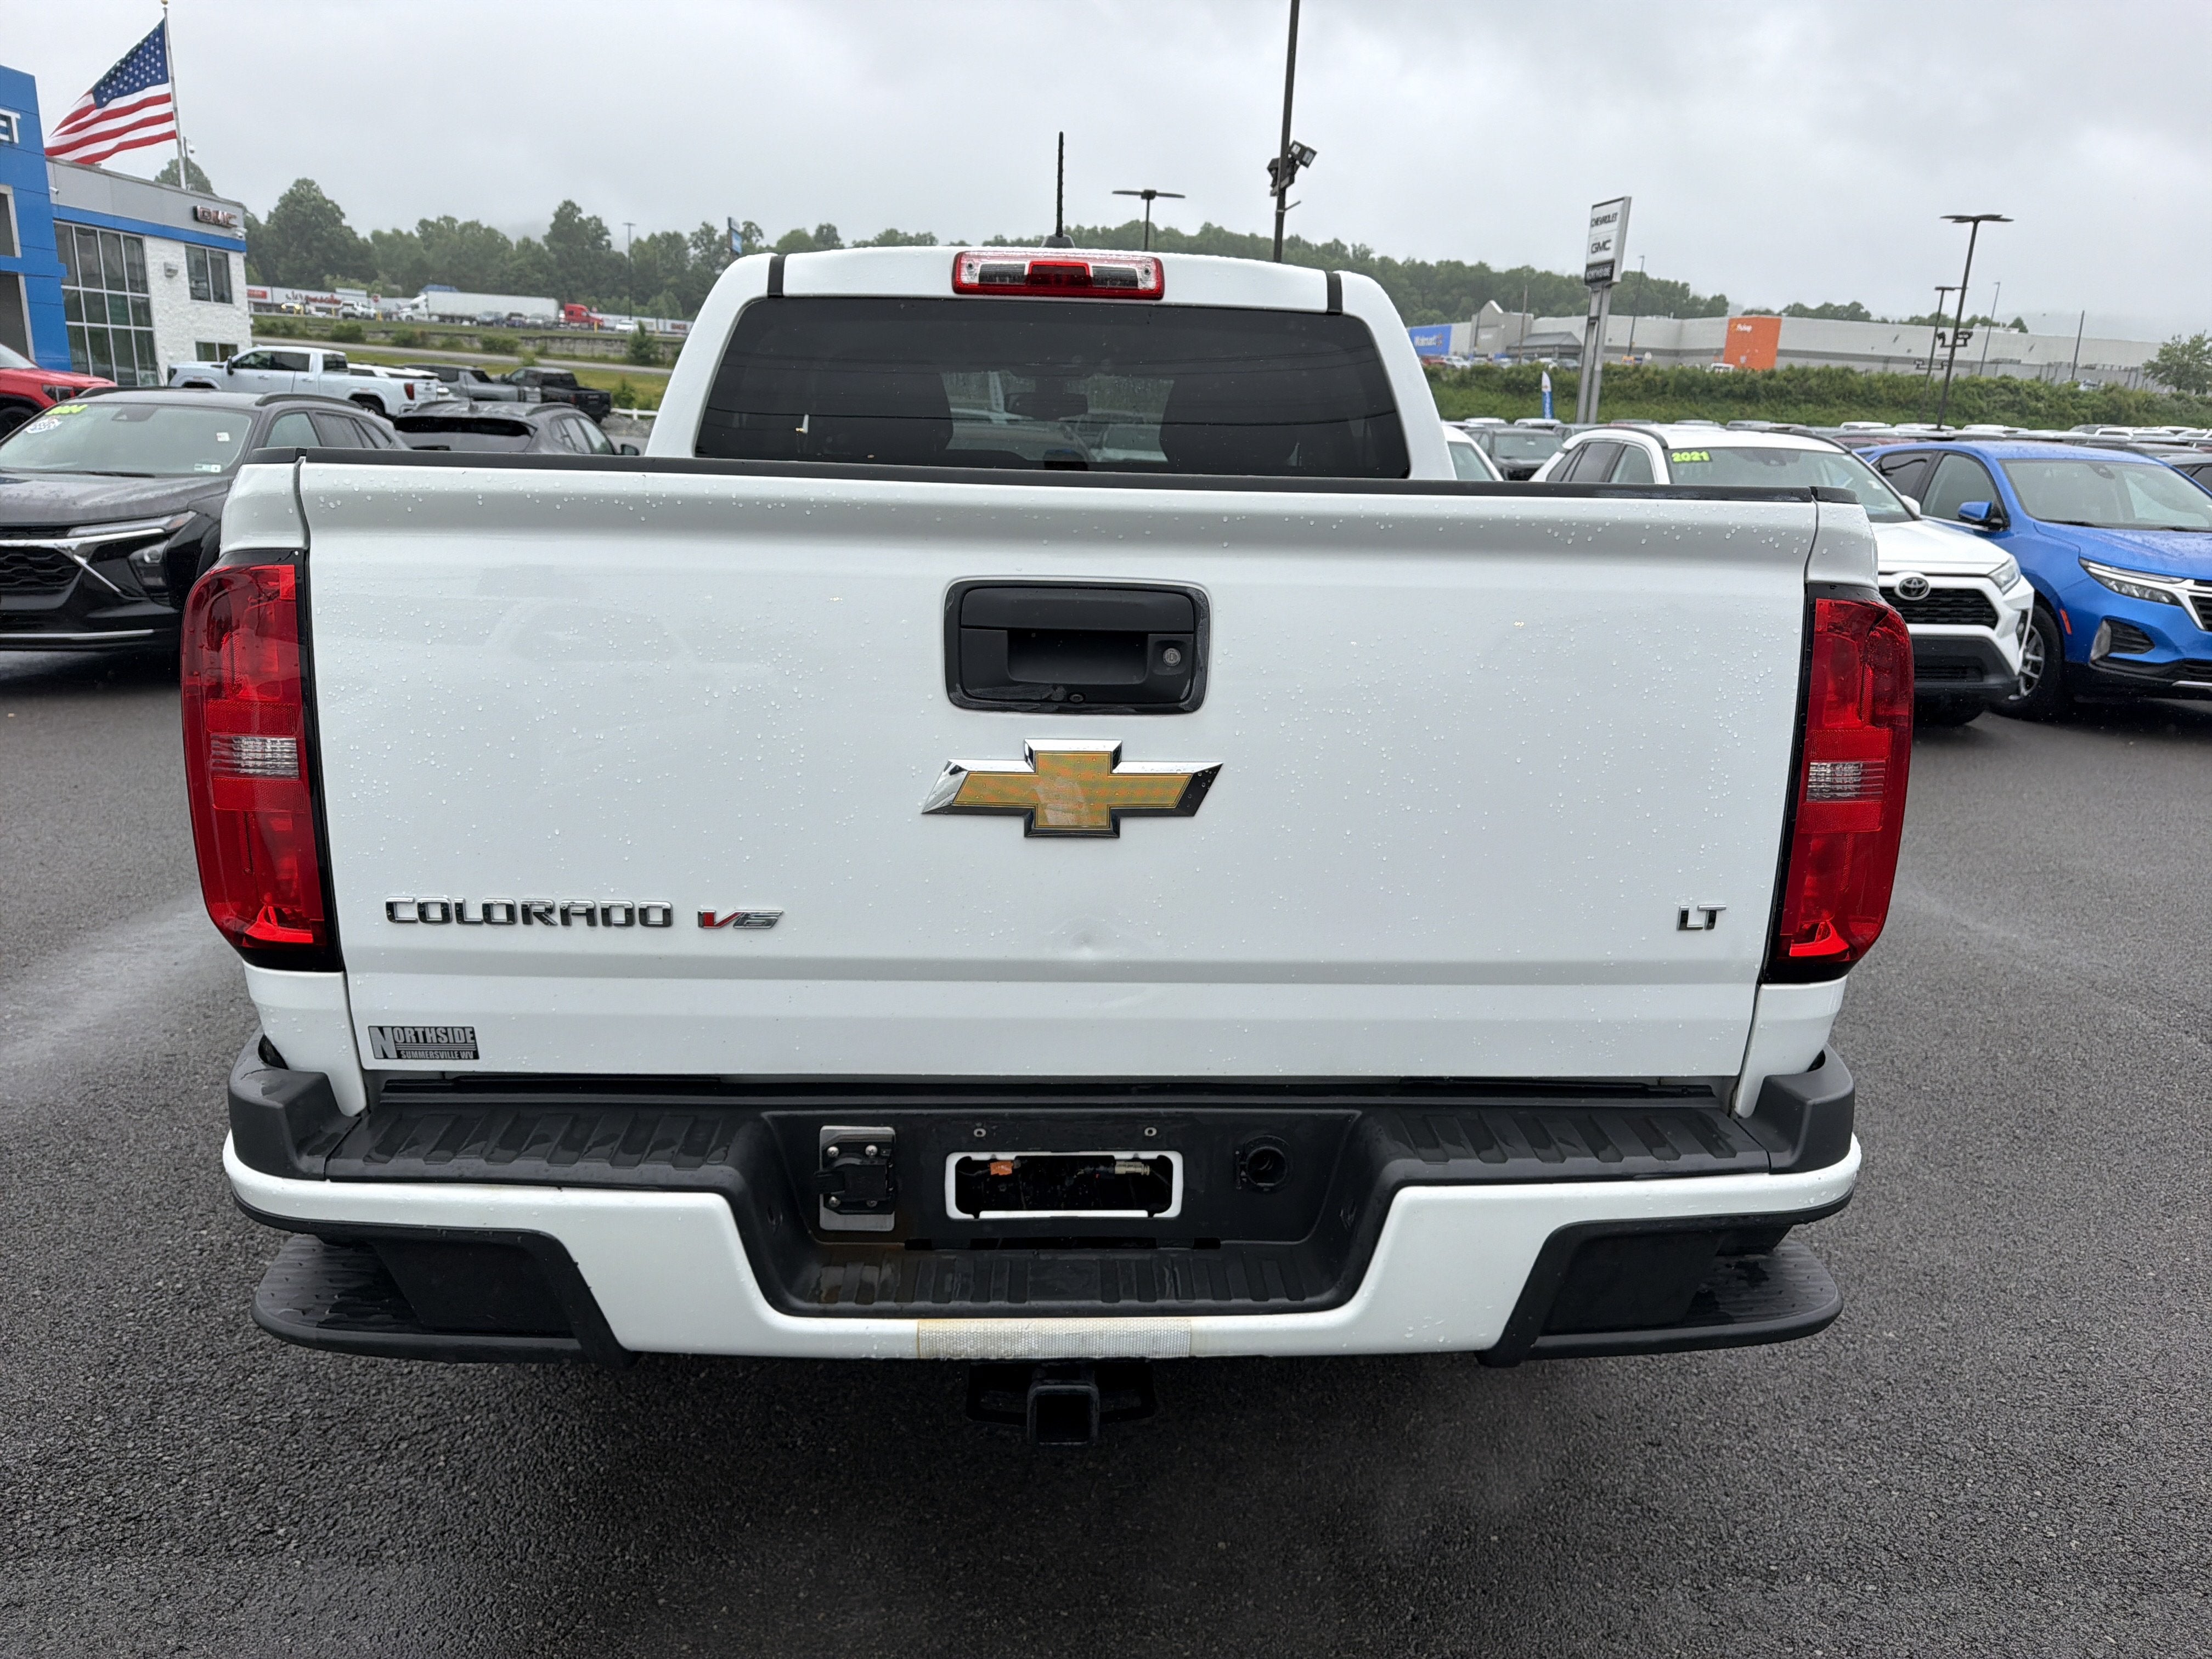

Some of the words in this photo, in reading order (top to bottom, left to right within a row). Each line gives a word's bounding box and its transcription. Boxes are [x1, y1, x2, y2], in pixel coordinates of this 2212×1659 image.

[194, 206, 237, 228] GMC
[1591, 212, 1618, 227] CHEVROLET
[1592, 239, 1611, 254] GMC
[1414, 335, 1437, 347] Walmart
[1671, 450, 1710, 462] 2021
[385, 896, 673, 928] COLORADO
[697, 909, 783, 929] V6
[1677, 905, 1726, 930] LT
[369, 1026, 475, 1059] NORTHSIDE
[400, 1050, 459, 1059] SUMMERSVILLE
[460, 1050, 474, 1059] WV
